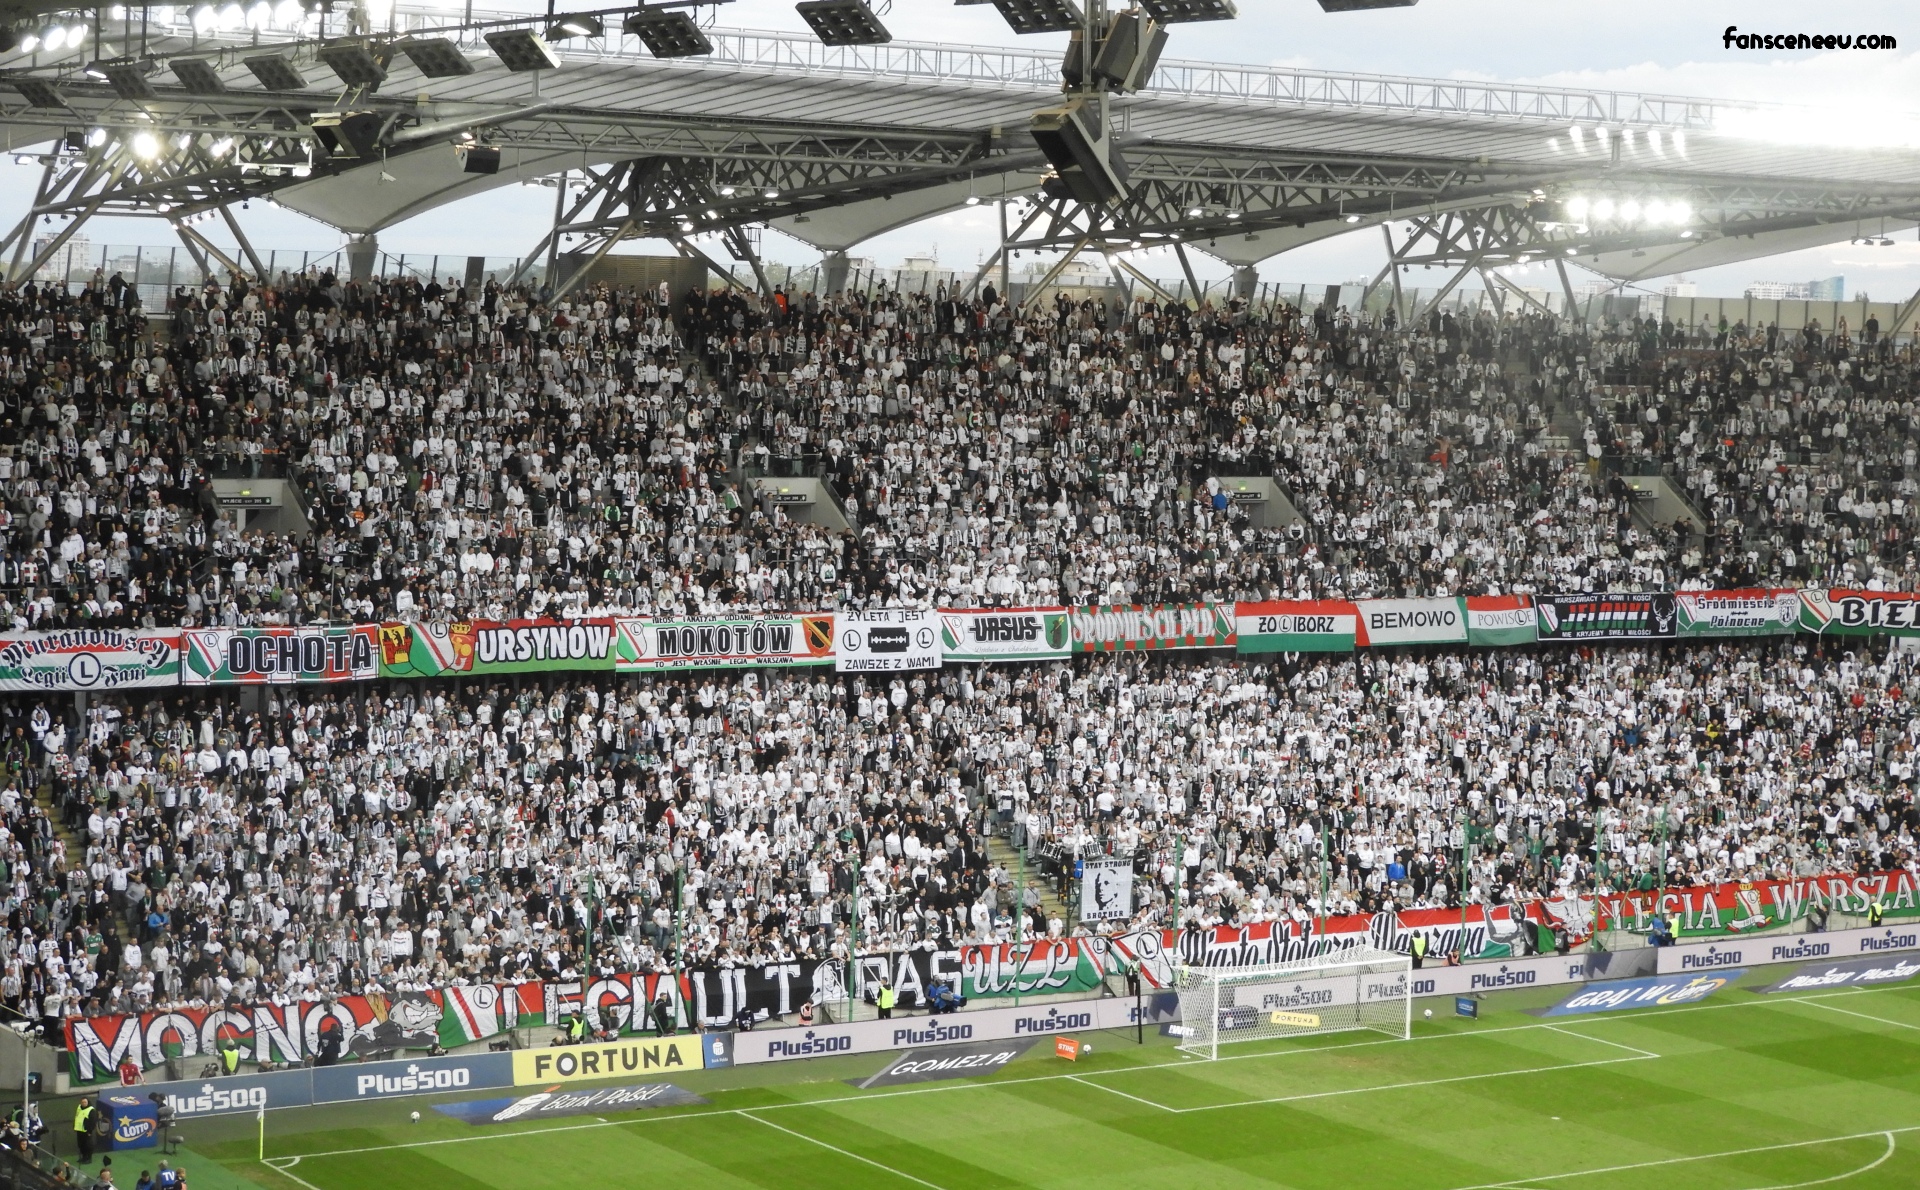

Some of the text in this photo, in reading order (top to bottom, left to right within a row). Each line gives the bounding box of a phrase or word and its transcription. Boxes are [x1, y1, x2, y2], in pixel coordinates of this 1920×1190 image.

[898, 610, 926, 623] JEST
[1371, 611, 1456, 629] BEMOWO
[1560, 602, 1651, 631] JELONKI
[656, 620, 794, 657] MOKOTÓW
[971, 615, 1042, 642] URSUS
[477, 619, 611, 664] URSYNÓW
[227, 633, 374, 675] OCHOTA
[693, 657, 722, 666] WŁAŚNIE
[729, 657, 748, 665] LEGIA
[845, 656, 935, 670] ZAWSZE Z WAMI
[21, 667, 67, 687] Legii
[103, 665, 147, 687] Fani
[1104, 859, 1131, 868] STRONG
[1086, 910, 1123, 919] BROTHER
[1771, 942, 1830, 959] Plus500
[1860, 934, 1917, 951] Plus500
[1681, 951, 1742, 968] Plus500
[1471, 970, 1536, 988] Plus500
[1778, 970, 1855, 989] Plus500
[1262, 989, 1332, 1009] Plus500
[1566, 987, 1643, 1008] GRAJ
[1635, 984, 1676, 1002] W
[1015, 1013, 1091, 1034] Plus500
[1275, 1014, 1314, 1024] FORTUNA
[72, 1001, 357, 1080] MOCNO
[893, 1024, 973, 1045] Plus500
[768, 1035, 852, 1057] Plus500
[1057, 1042, 1075, 1053] STIHL
[535, 1043, 684, 1079] FORTUNA
[890, 1050, 1017, 1075] GOMEZ.PL
[357, 1067, 470, 1095] Plus500
[123, 1122, 149, 1138] LOTTO
[162, 1172, 176, 1181] TV
